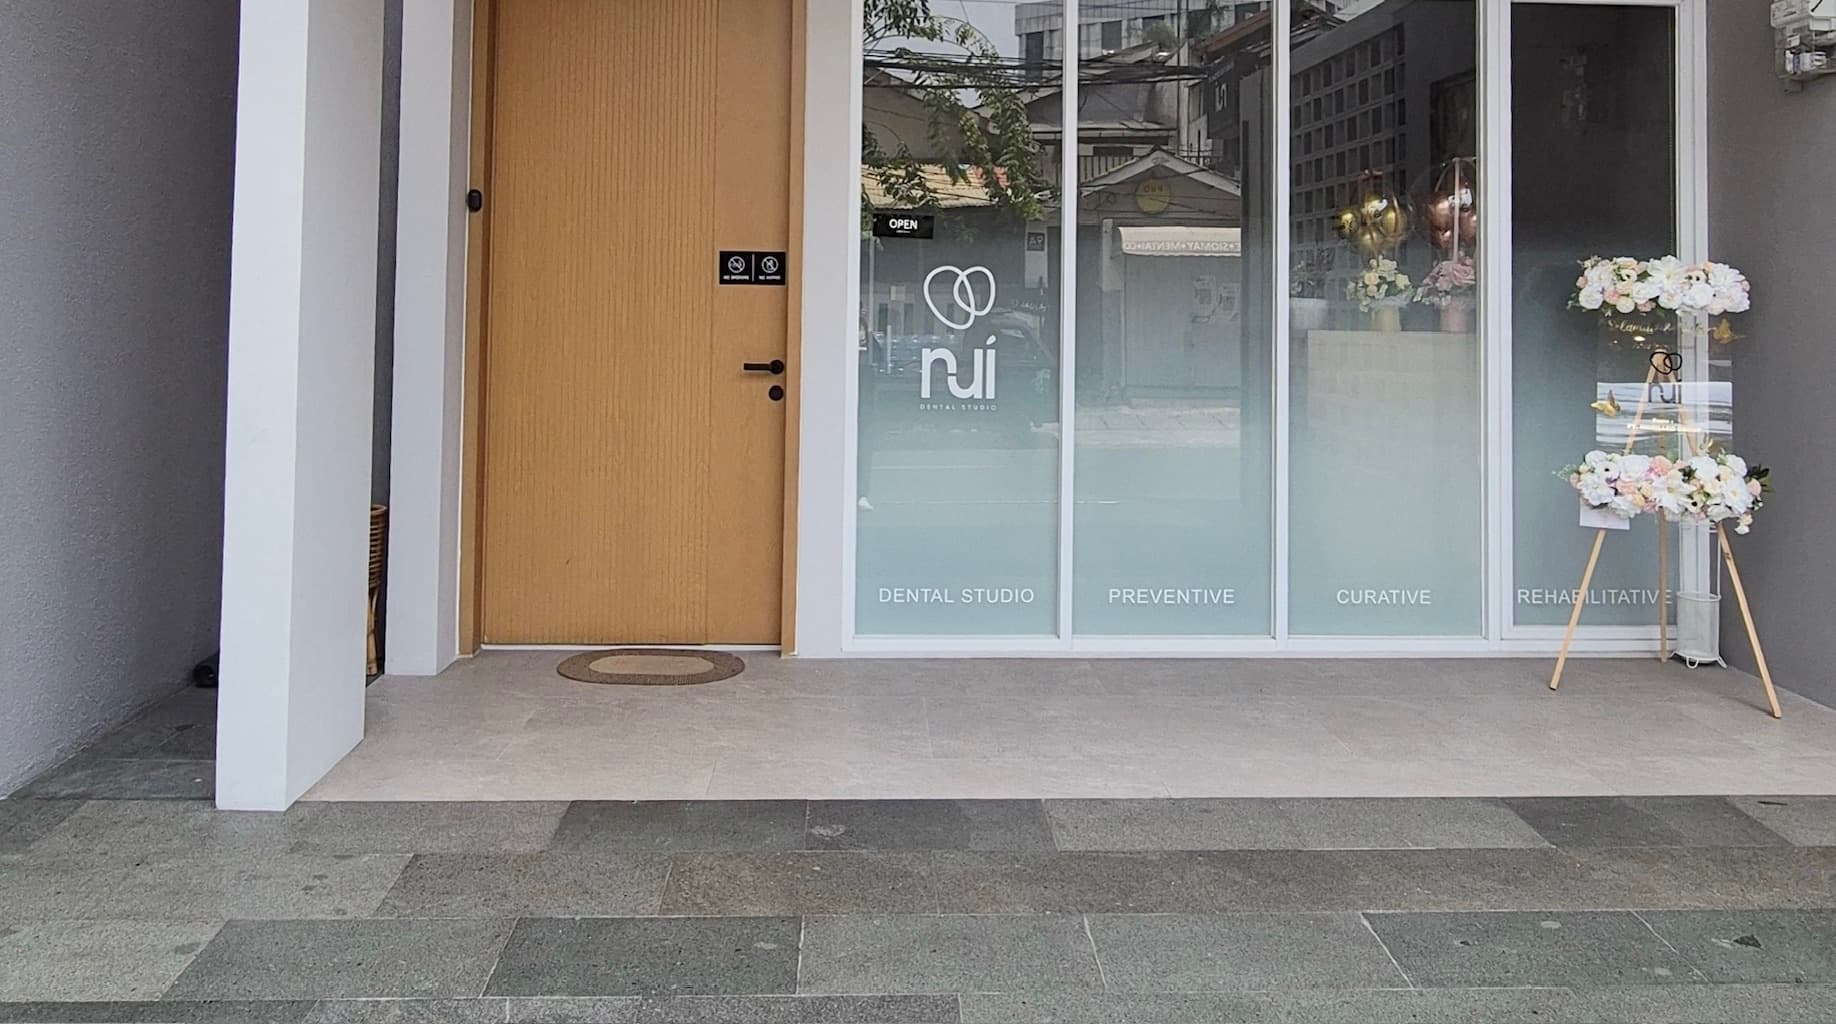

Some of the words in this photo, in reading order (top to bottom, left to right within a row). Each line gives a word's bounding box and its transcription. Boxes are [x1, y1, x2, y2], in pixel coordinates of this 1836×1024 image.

[889, 218, 918, 230] OPEN
[919, 403, 957, 411] DENTAL
[960, 403, 997, 411] STUDIO
[879, 588, 955, 603] DENTAL
[961, 588, 1034, 603] STUDIO
[1108, 588, 1235, 604] PREVENTIVE
[1336, 589, 1432, 604] CURATIVE
